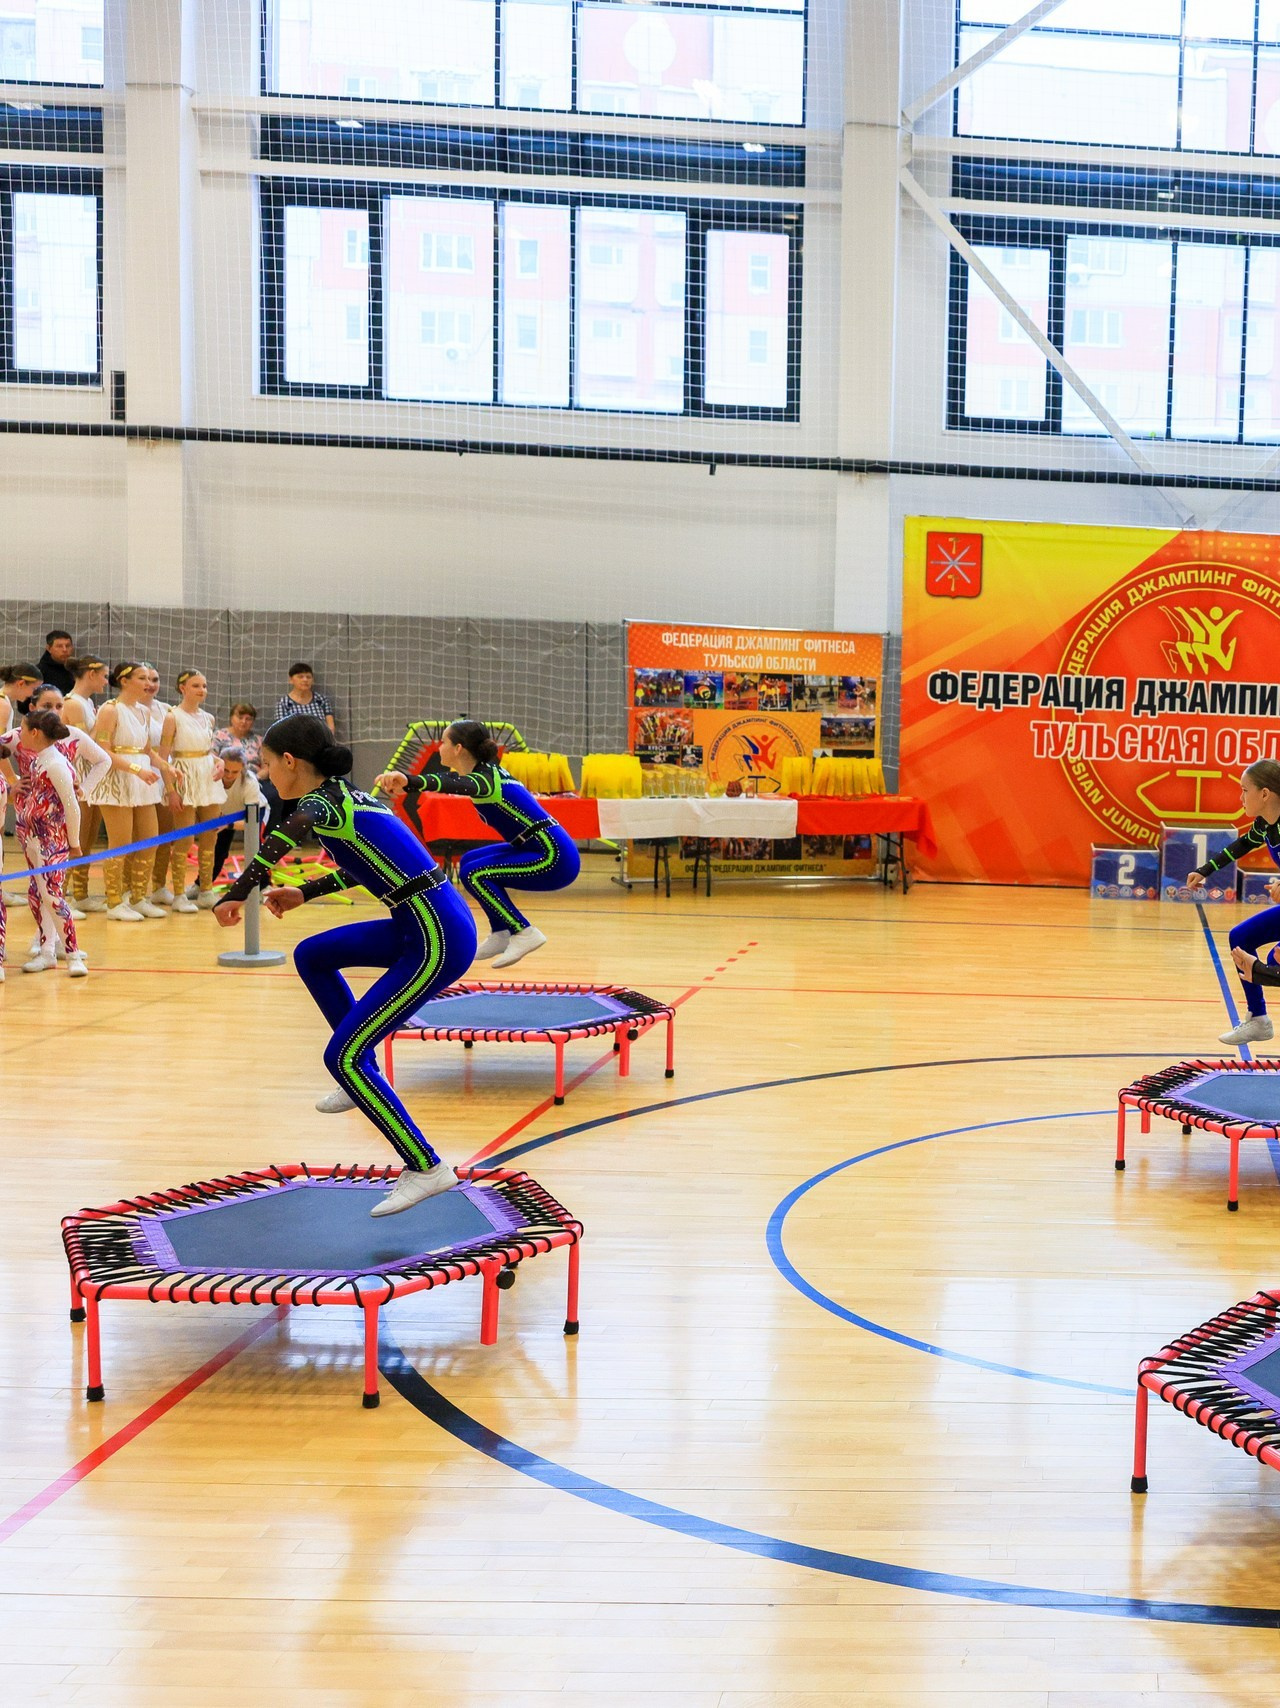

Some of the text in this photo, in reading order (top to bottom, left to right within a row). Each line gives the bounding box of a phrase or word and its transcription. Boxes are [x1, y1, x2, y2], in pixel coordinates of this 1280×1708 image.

[661, 631, 856, 654] ФЕДЕРАЦИЯ ДЖАМПИНГ ФИТНЕСА
[1066, 598, 1125, 676] ДЕРАЦИЯ
[1126, 569, 1237, 606] ДЖАМПИНГ
[703, 653, 817, 672] ТУЛЬСКОЙ ОБЛАСТИ
[928, 670, 1126, 714] ФЕДЕРАЦИЯ
[1031, 720, 1208, 765] ТУЛЬСКАЯ
[1117, 854, 1136, 886] 2
[1192, 834, 1208, 885] 1
